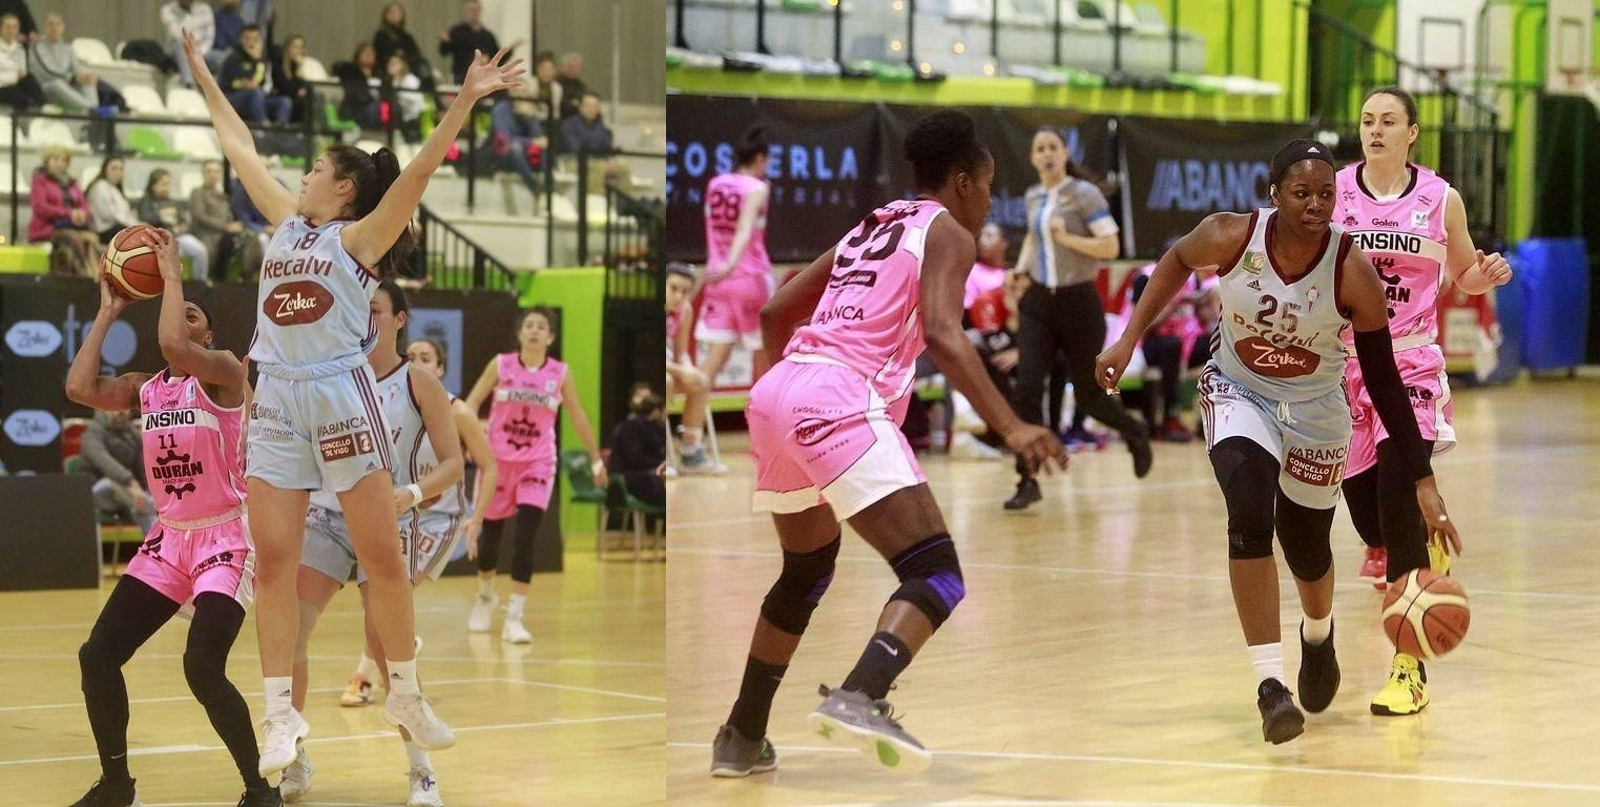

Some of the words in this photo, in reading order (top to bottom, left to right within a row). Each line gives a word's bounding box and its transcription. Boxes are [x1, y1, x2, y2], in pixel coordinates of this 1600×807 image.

[292, 231, 321, 252] 18
[263, 255, 334, 280] Recalvi
[274, 292, 317, 318] Zorka
[1255, 294, 1301, 334] 25
[1251, 343, 1307, 369] Zorka
[158, 433, 178, 449] 11
[321, 438, 351, 450] CONCELLO
[152, 461, 204, 479] DURAN
[1290, 457, 1330, 475] CONCELLO
[1291, 466, 1302, 476] DE
[1304, 471, 1323, 481] VIGO
